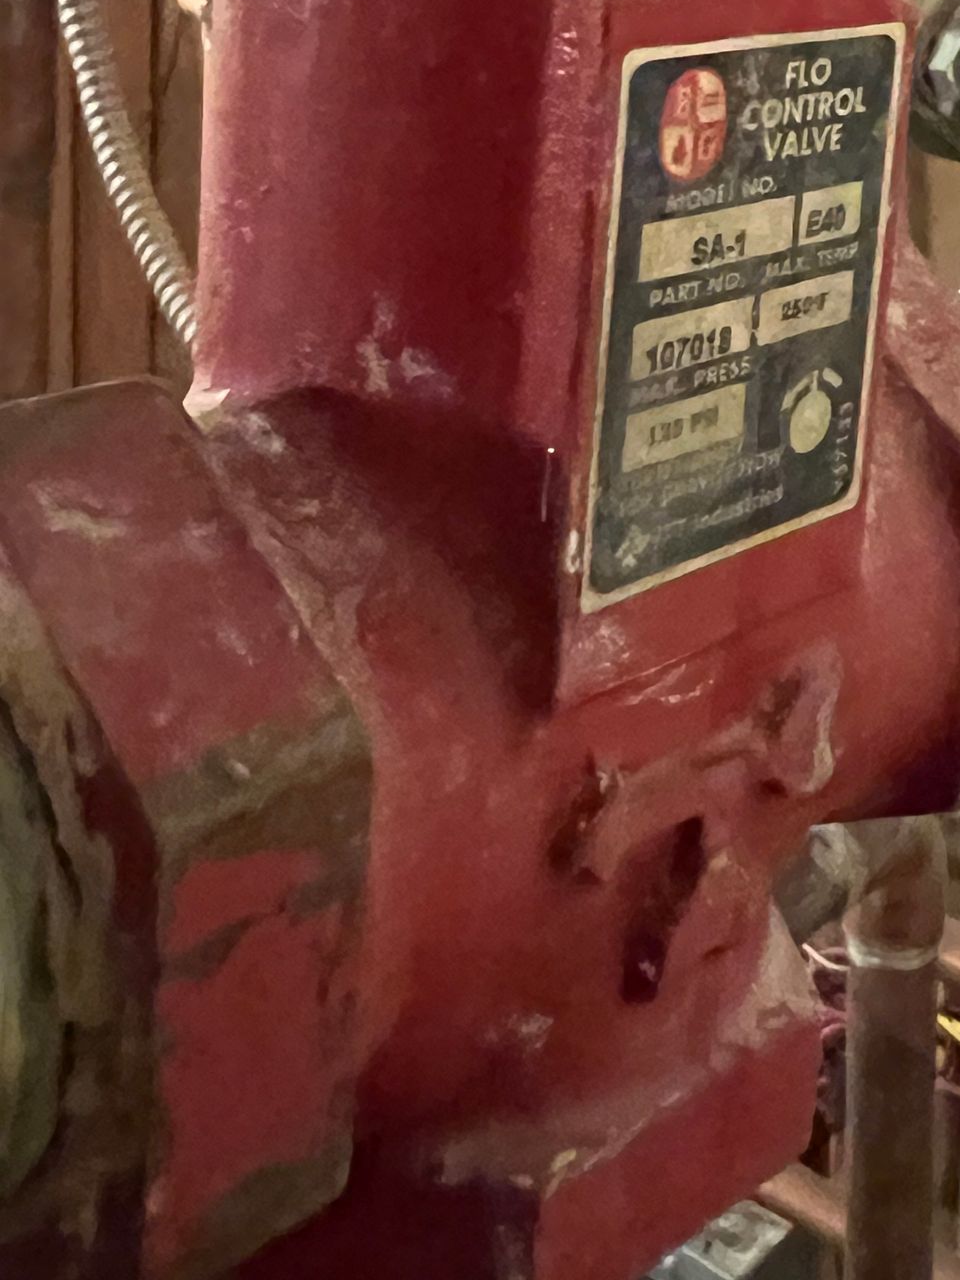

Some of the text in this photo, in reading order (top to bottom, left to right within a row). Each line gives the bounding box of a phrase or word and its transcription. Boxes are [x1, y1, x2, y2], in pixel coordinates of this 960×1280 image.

[785, 57, 832, 90] FLO
[740, 86, 867, 131] CONTROL
[763, 123, 844, 162] VALVE
[690, 228, 747, 266] SA-1
[650, 280, 703, 308] PART
